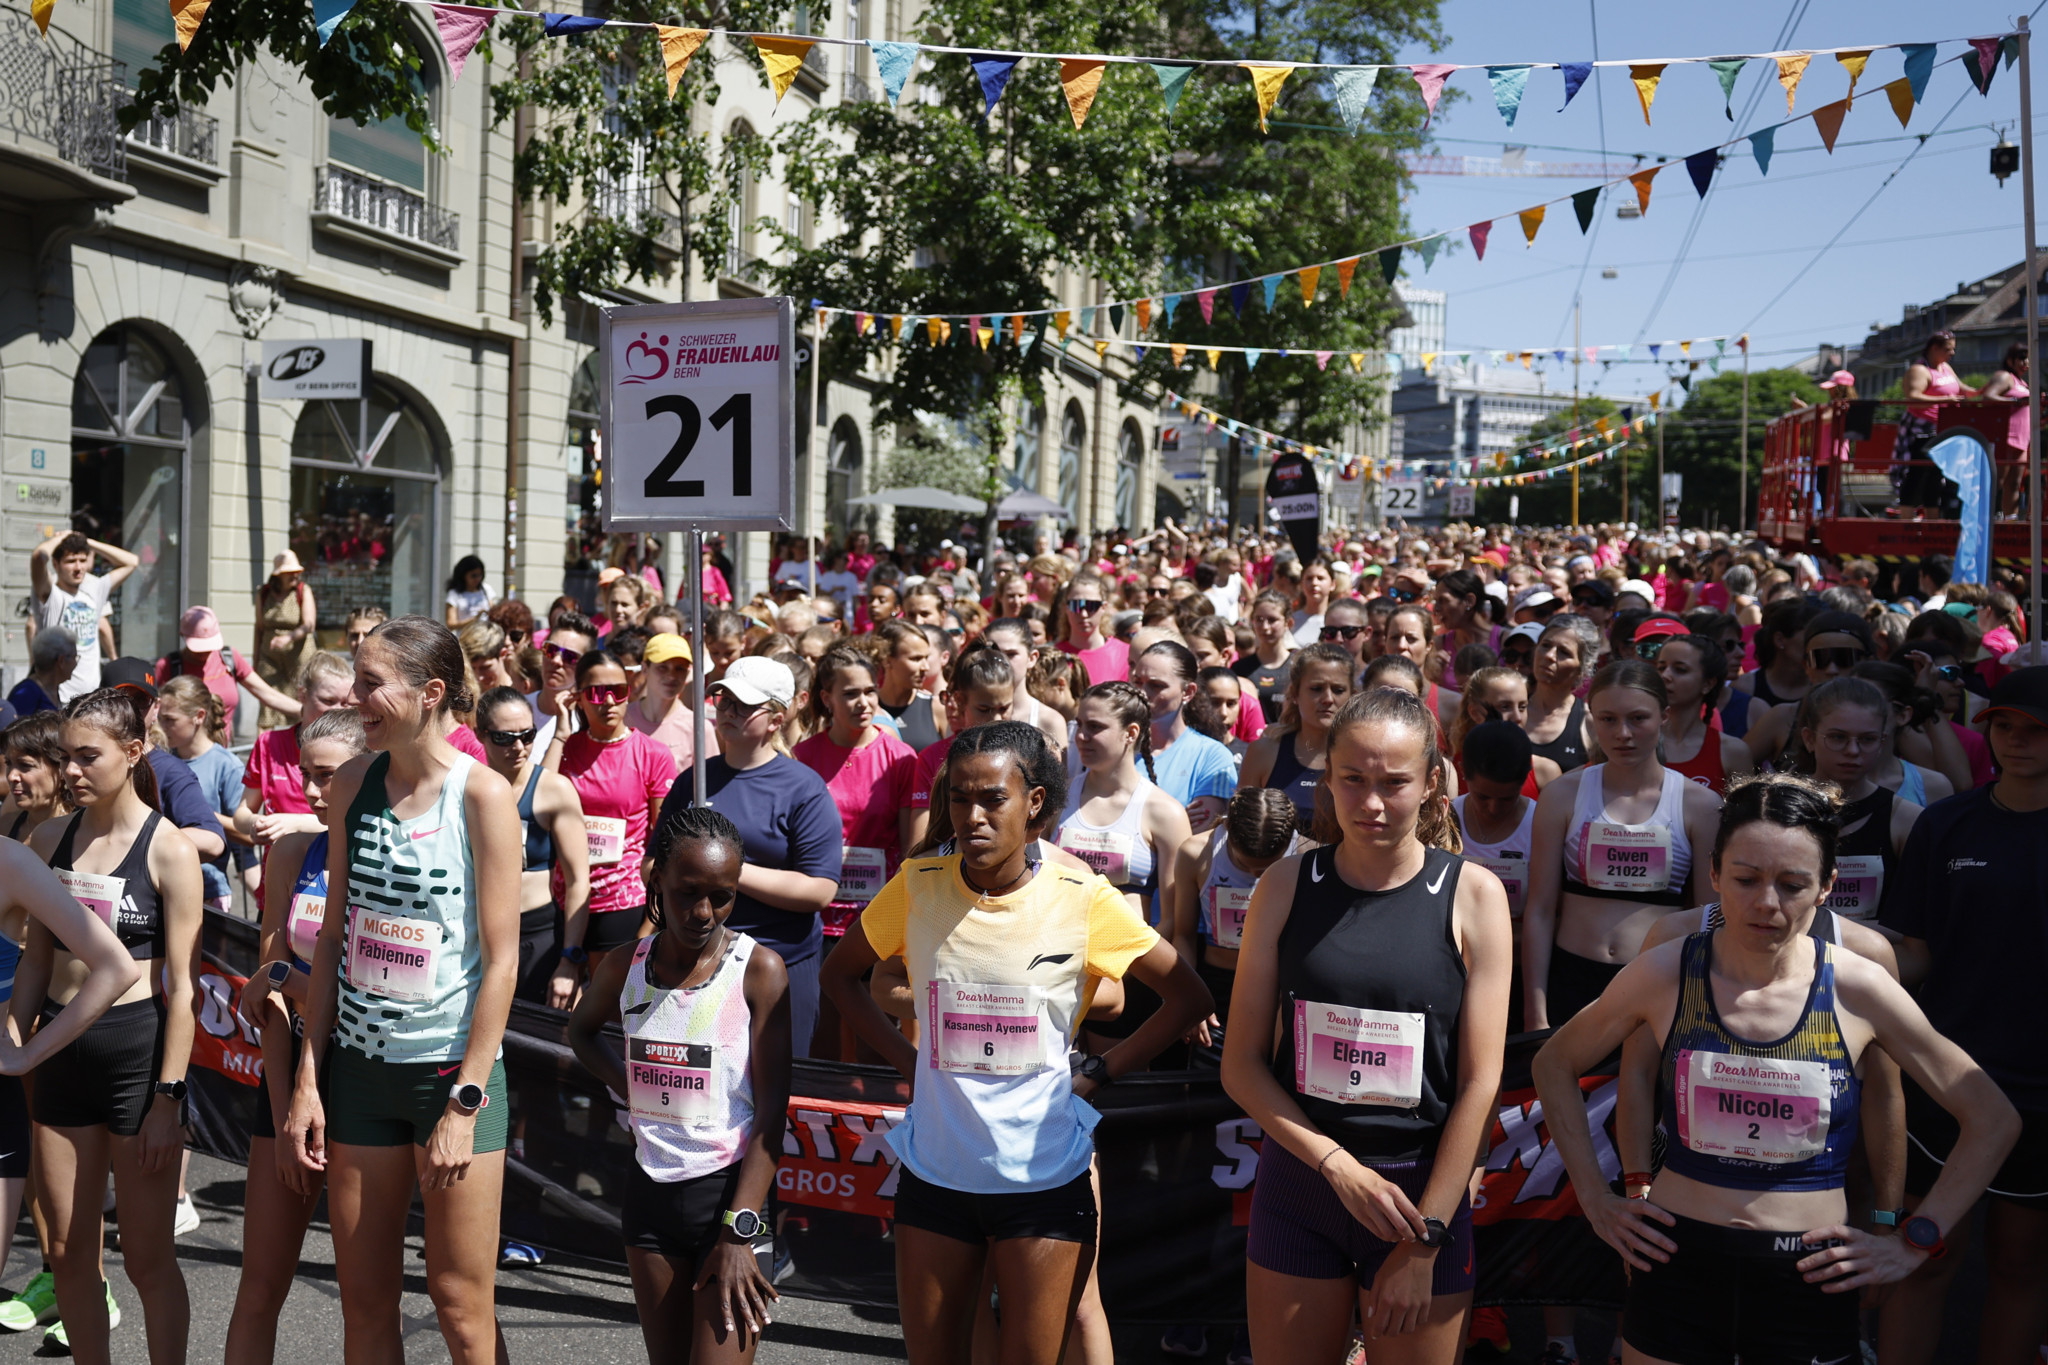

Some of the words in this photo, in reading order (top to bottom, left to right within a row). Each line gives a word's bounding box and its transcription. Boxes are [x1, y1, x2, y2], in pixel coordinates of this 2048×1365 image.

[679, 333, 737, 347] SCHWEIZER
[295, 349, 321, 371] ICF
[673, 366, 701, 379] BERN
[295, 382, 306, 390] ICF
[309, 382, 329, 390] BERN
[331, 382, 358, 390] OFFICE
[644, 393, 752, 497] 21
[33, 450, 42, 467] 8
[1386, 488, 1418, 509] 22
[585, 820, 615, 833] GROS
[588, 836, 607, 846] nda
[1607, 847, 1649, 863] Gwen
[842, 867, 877, 879] smine
[1607, 864, 1647, 877] 21022
[359, 940, 425, 968] Fabienne
[382, 966, 388, 980] 1
[944, 1019, 993, 1032] Kasanesh
[995, 1023, 1037, 1035] Ayenew
[645, 1043, 690, 1062] SPORTXX
[984, 1041, 994, 1056] 6
[1333, 1040, 1387, 1067] Elena
[633, 1066, 704, 1091] Feliciana
[1350, 1070, 1361, 1086] 9
[1713, 1076, 1736, 1084] BREAST
[1737, 1079, 1762, 1087] CANCER
[1830, 1068, 1846, 1080] HAL
[1678, 1074, 1686, 1094] Egger
[661, 1092, 669, 1105] 5
[1361, 1095, 1390, 1103] MIGROS
[1719, 1092, 1794, 1120] Nicole
[1748, 1123, 1760, 1140] 2
[1762, 1151, 1794, 1159] MIGROS
[1717, 1157, 1764, 1169] CRAFT
[776, 1167, 856, 1197] GROS
